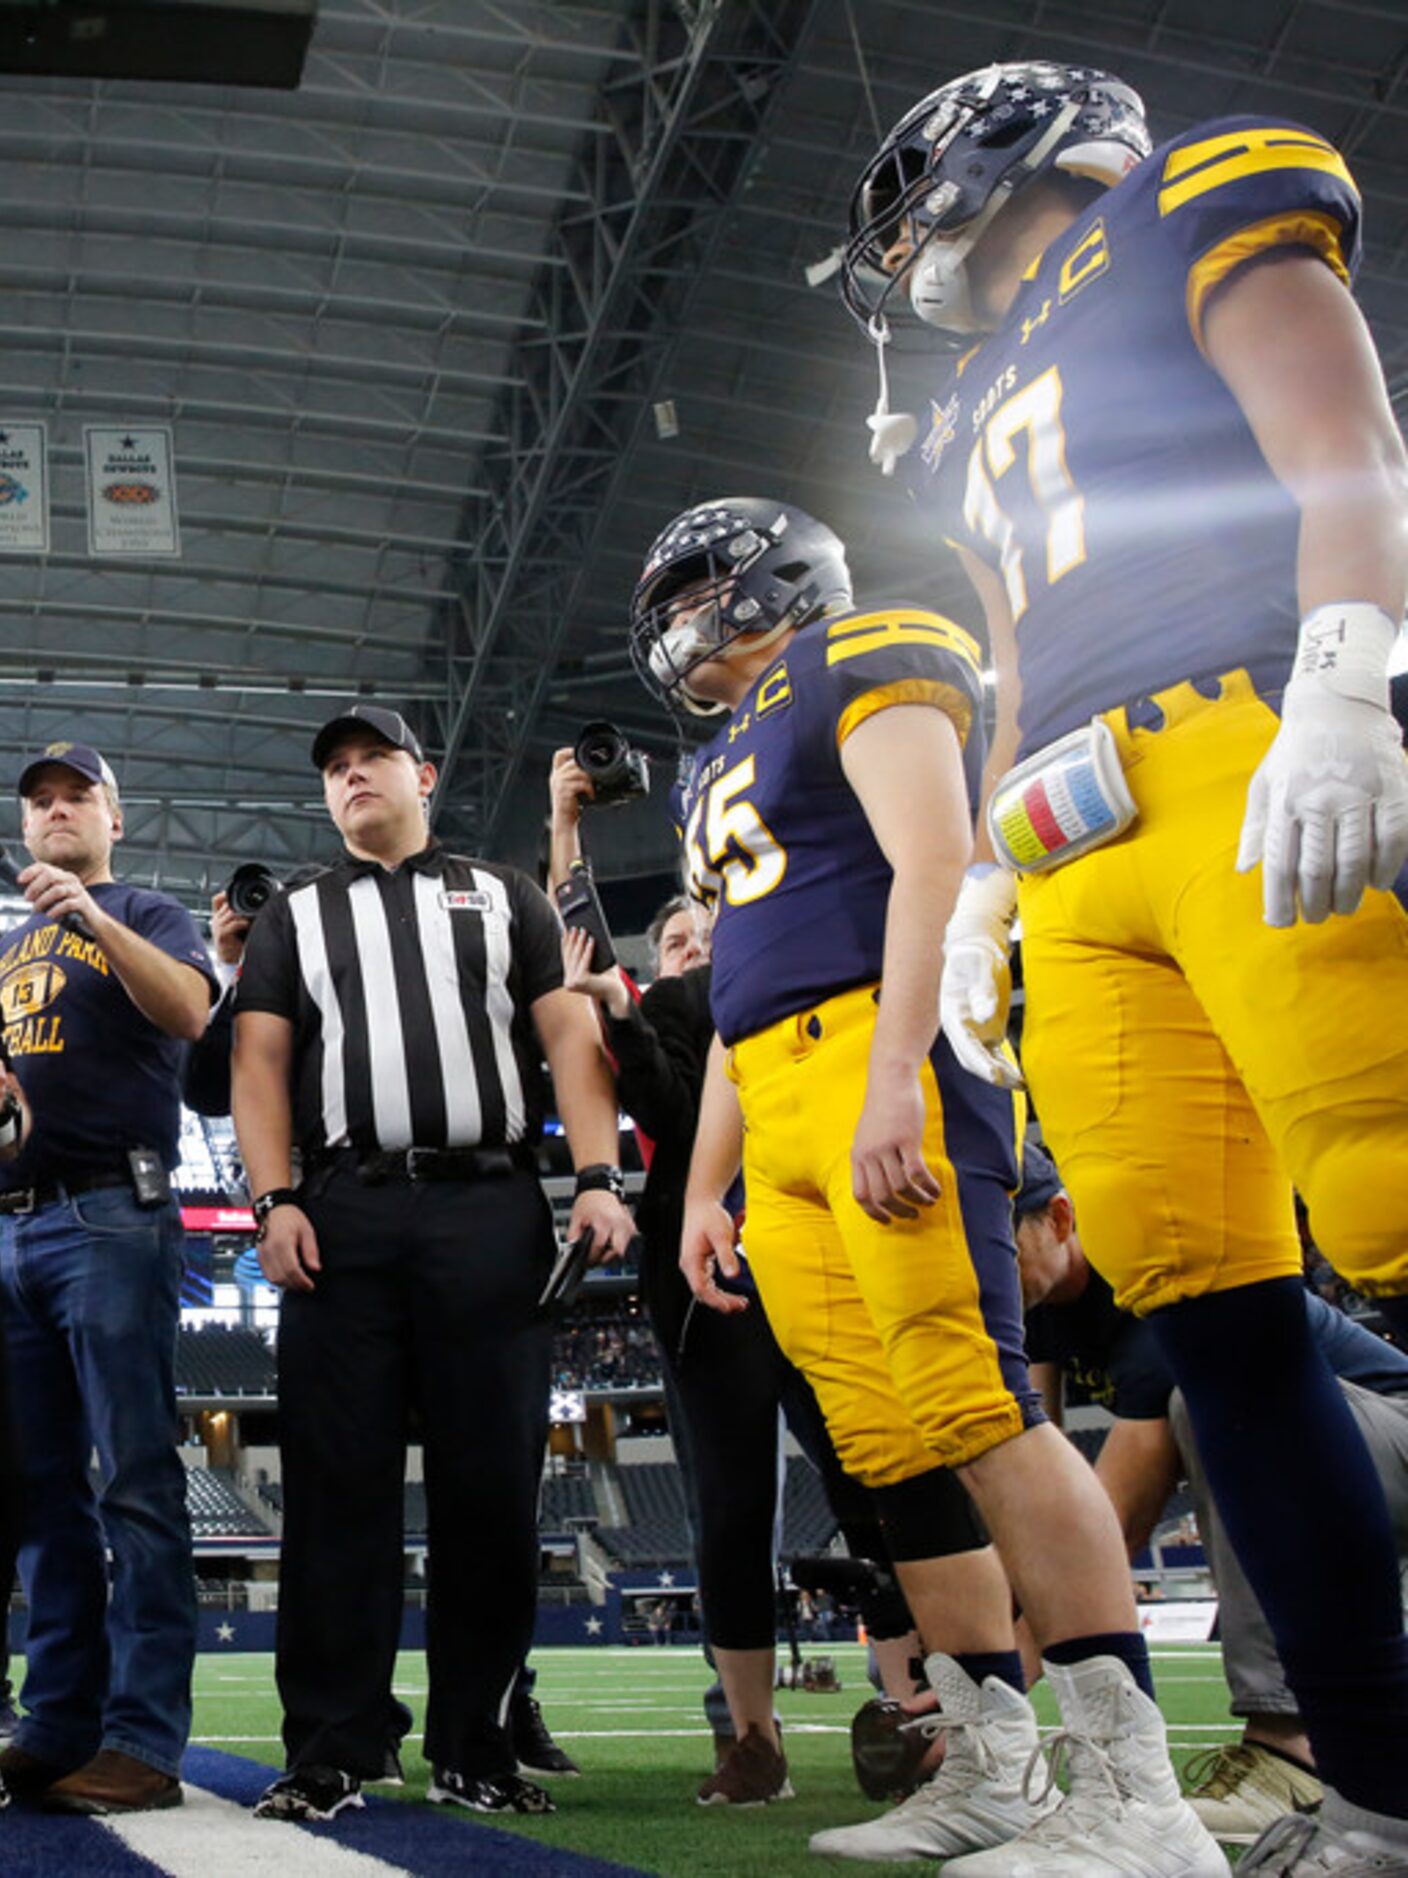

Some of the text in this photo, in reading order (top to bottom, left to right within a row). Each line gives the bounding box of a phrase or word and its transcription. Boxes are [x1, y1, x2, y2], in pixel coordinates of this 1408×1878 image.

[1059, 227, 1106, 296] C
[102, 463, 156, 474] COWBOYS
[107, 454, 151, 463] DALLAS
[756, 666, 792, 713] C
[12, 982, 34, 1008] 13
